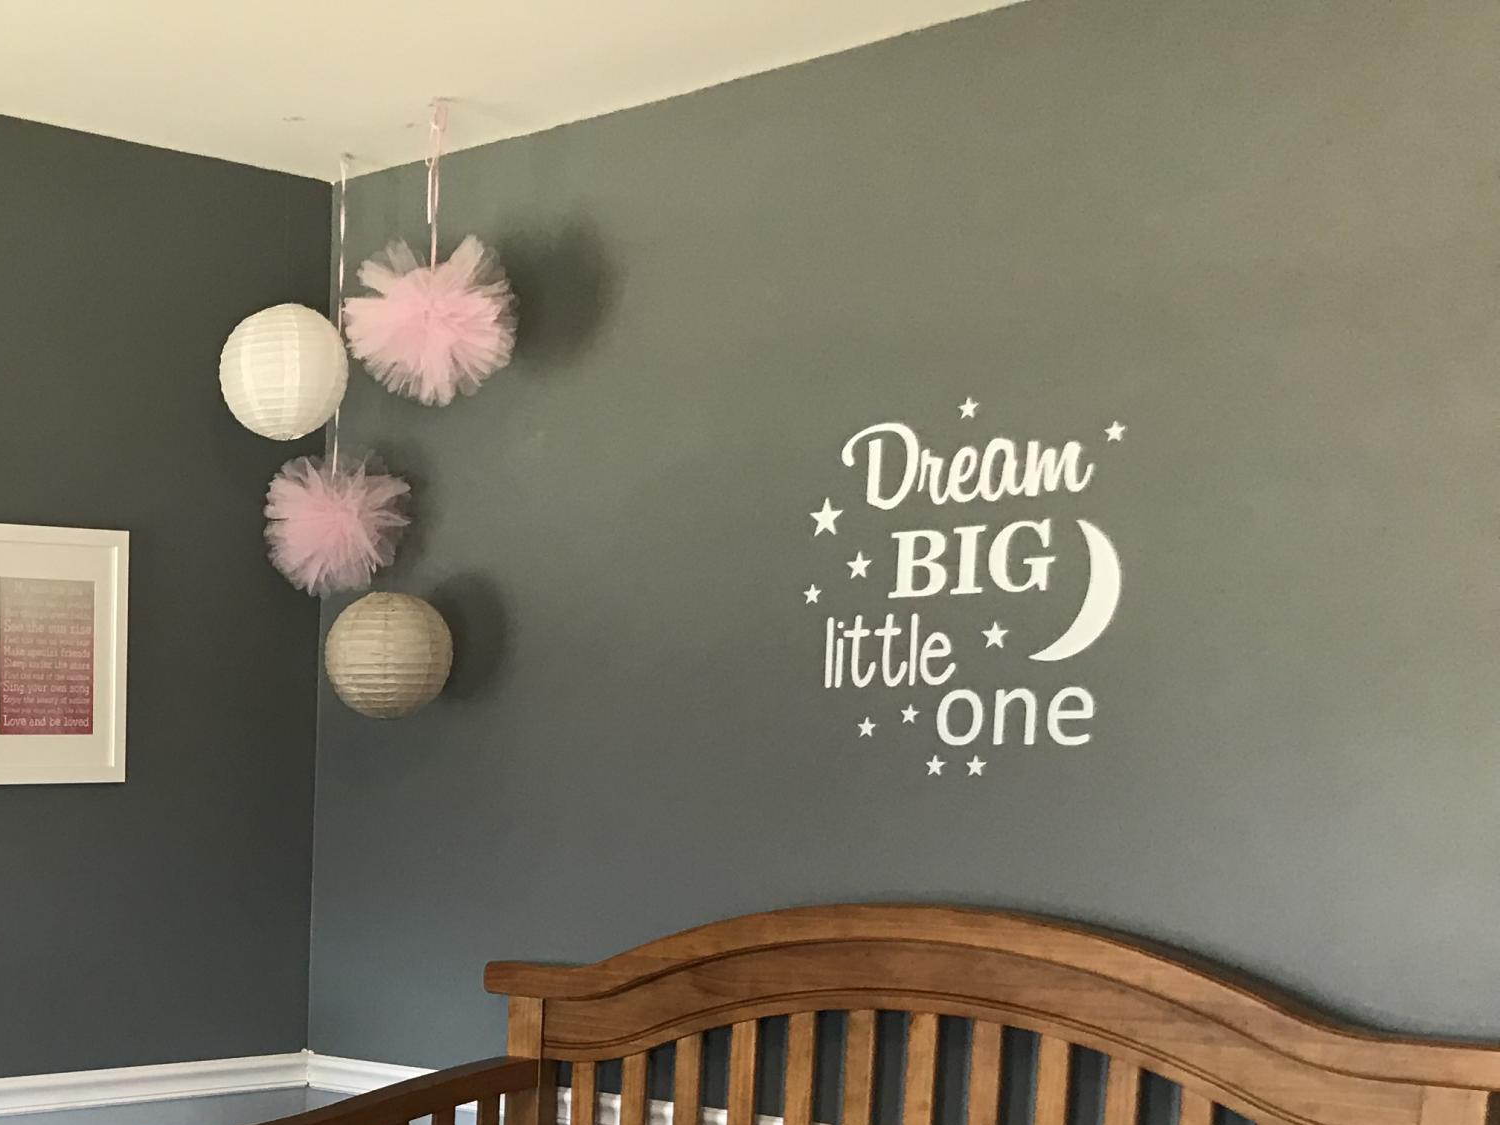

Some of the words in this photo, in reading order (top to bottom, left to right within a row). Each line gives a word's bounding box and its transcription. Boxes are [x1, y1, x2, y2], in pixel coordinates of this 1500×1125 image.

[841, 422, 1097, 510] Dream
[888, 518, 1056, 599] BIG
[824, 613, 956, 688] little
[3, 681, 24, 694] Sing
[26, 683, 47, 694] your
[69, 685, 89, 696] song
[3, 714, 27, 726] Love
[29, 716, 46, 727] and
[49, 716, 61, 727] be
[63, 716, 89, 727] loved
[936, 686, 1095, 746] one
